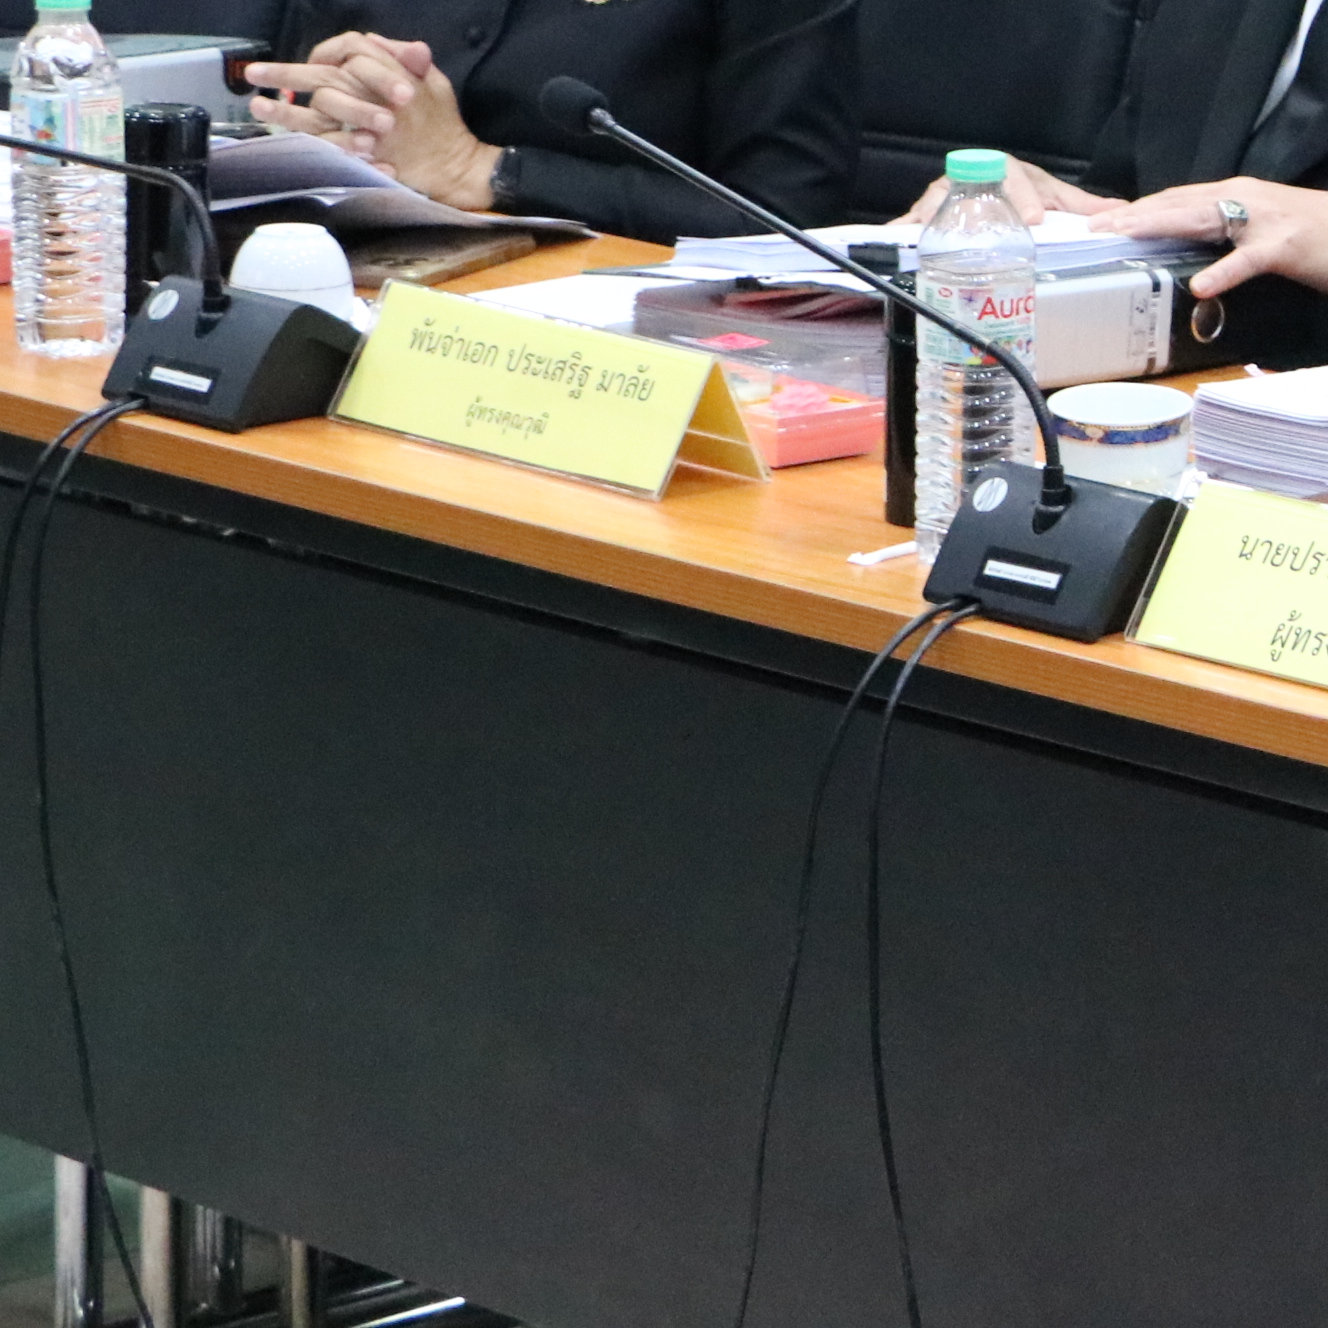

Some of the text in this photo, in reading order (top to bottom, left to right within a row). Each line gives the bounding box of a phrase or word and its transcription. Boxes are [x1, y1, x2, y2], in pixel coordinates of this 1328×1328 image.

[408, 317, 656, 401] พันจ่าเอก ประเสริฐ มาลัย
